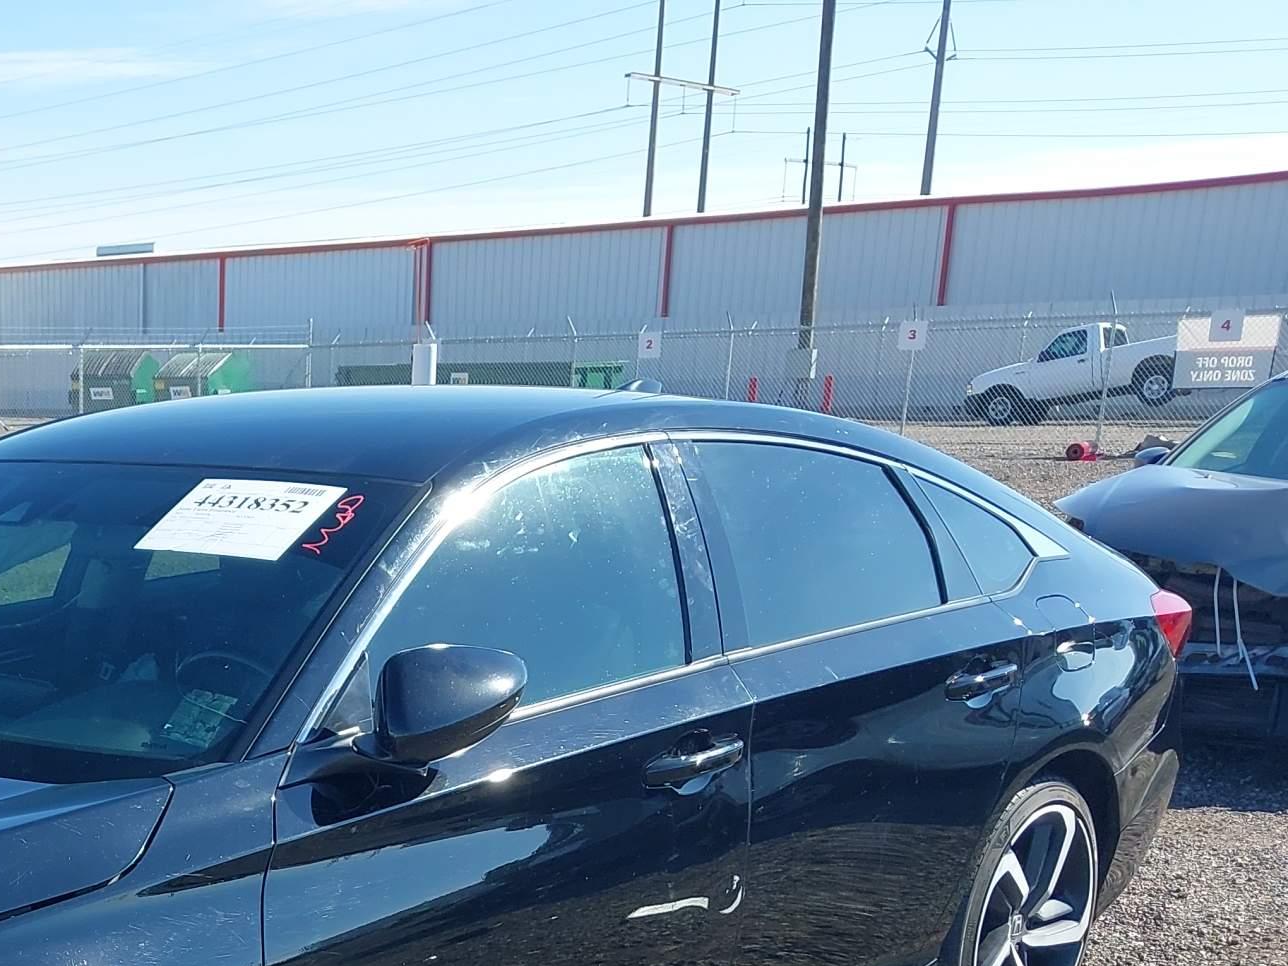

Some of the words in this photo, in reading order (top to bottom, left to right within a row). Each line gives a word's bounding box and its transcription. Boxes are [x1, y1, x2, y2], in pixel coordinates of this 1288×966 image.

[1221, 319, 1231, 331] 4
[908, 329, 917, 340] 3
[646, 339, 653, 350] 2
[194, 494, 309, 513] 44318352
